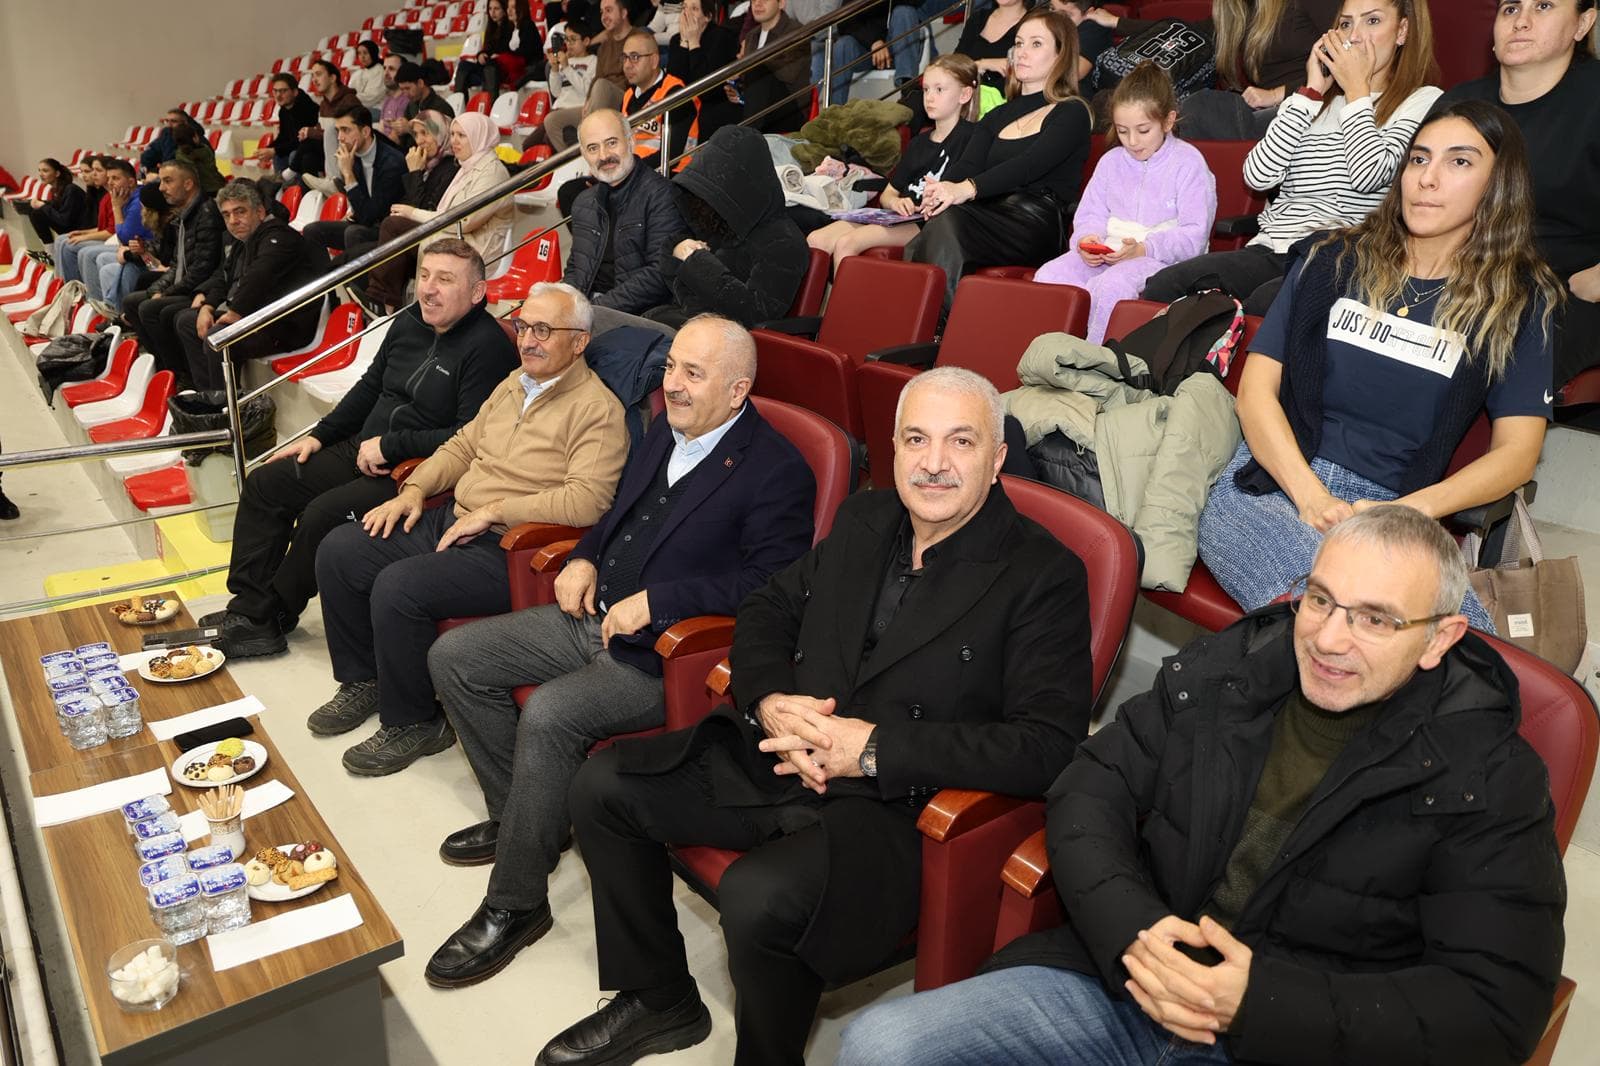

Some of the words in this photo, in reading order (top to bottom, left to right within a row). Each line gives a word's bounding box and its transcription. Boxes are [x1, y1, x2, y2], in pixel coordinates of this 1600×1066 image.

[540, 244, 549, 256] 16
[1332, 308, 1372, 336] JUST
[1369, 320, 1392, 344] DO
